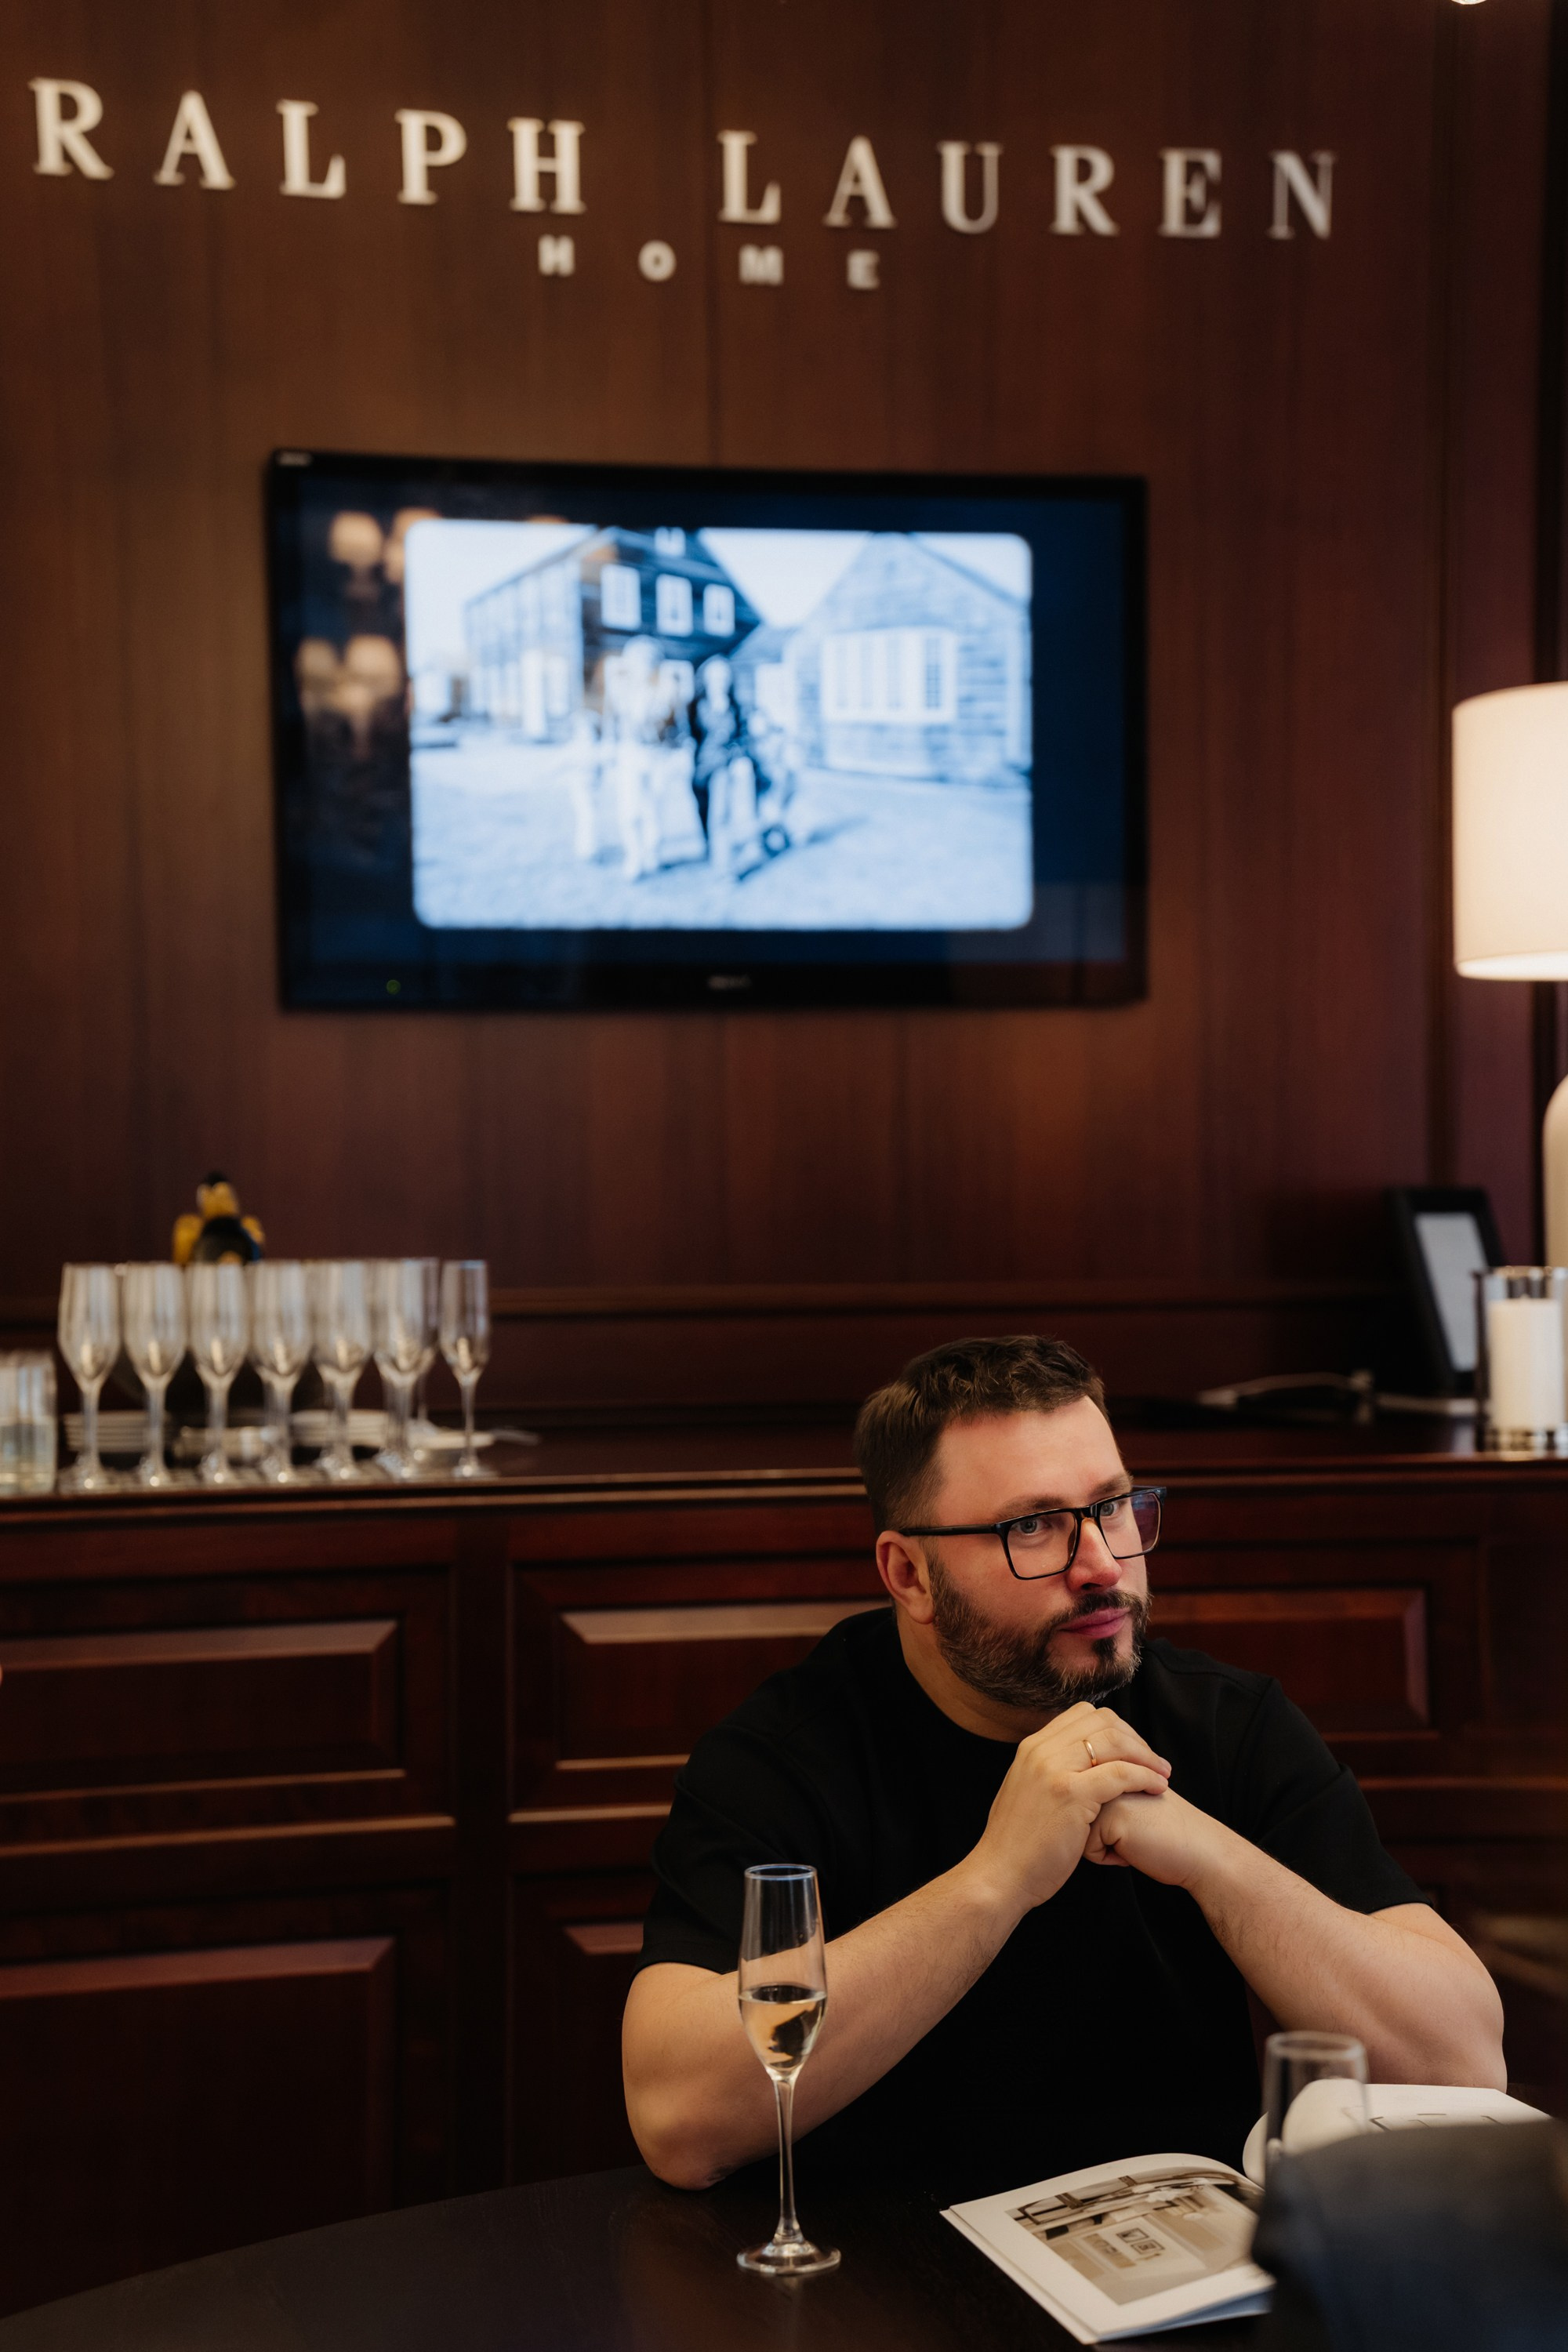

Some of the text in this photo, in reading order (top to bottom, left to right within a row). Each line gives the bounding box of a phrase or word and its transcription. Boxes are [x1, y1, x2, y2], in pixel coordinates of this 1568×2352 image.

[29, 77, 1335, 240] RALPH LAUREN
[538, 234, 880, 289] HOME
